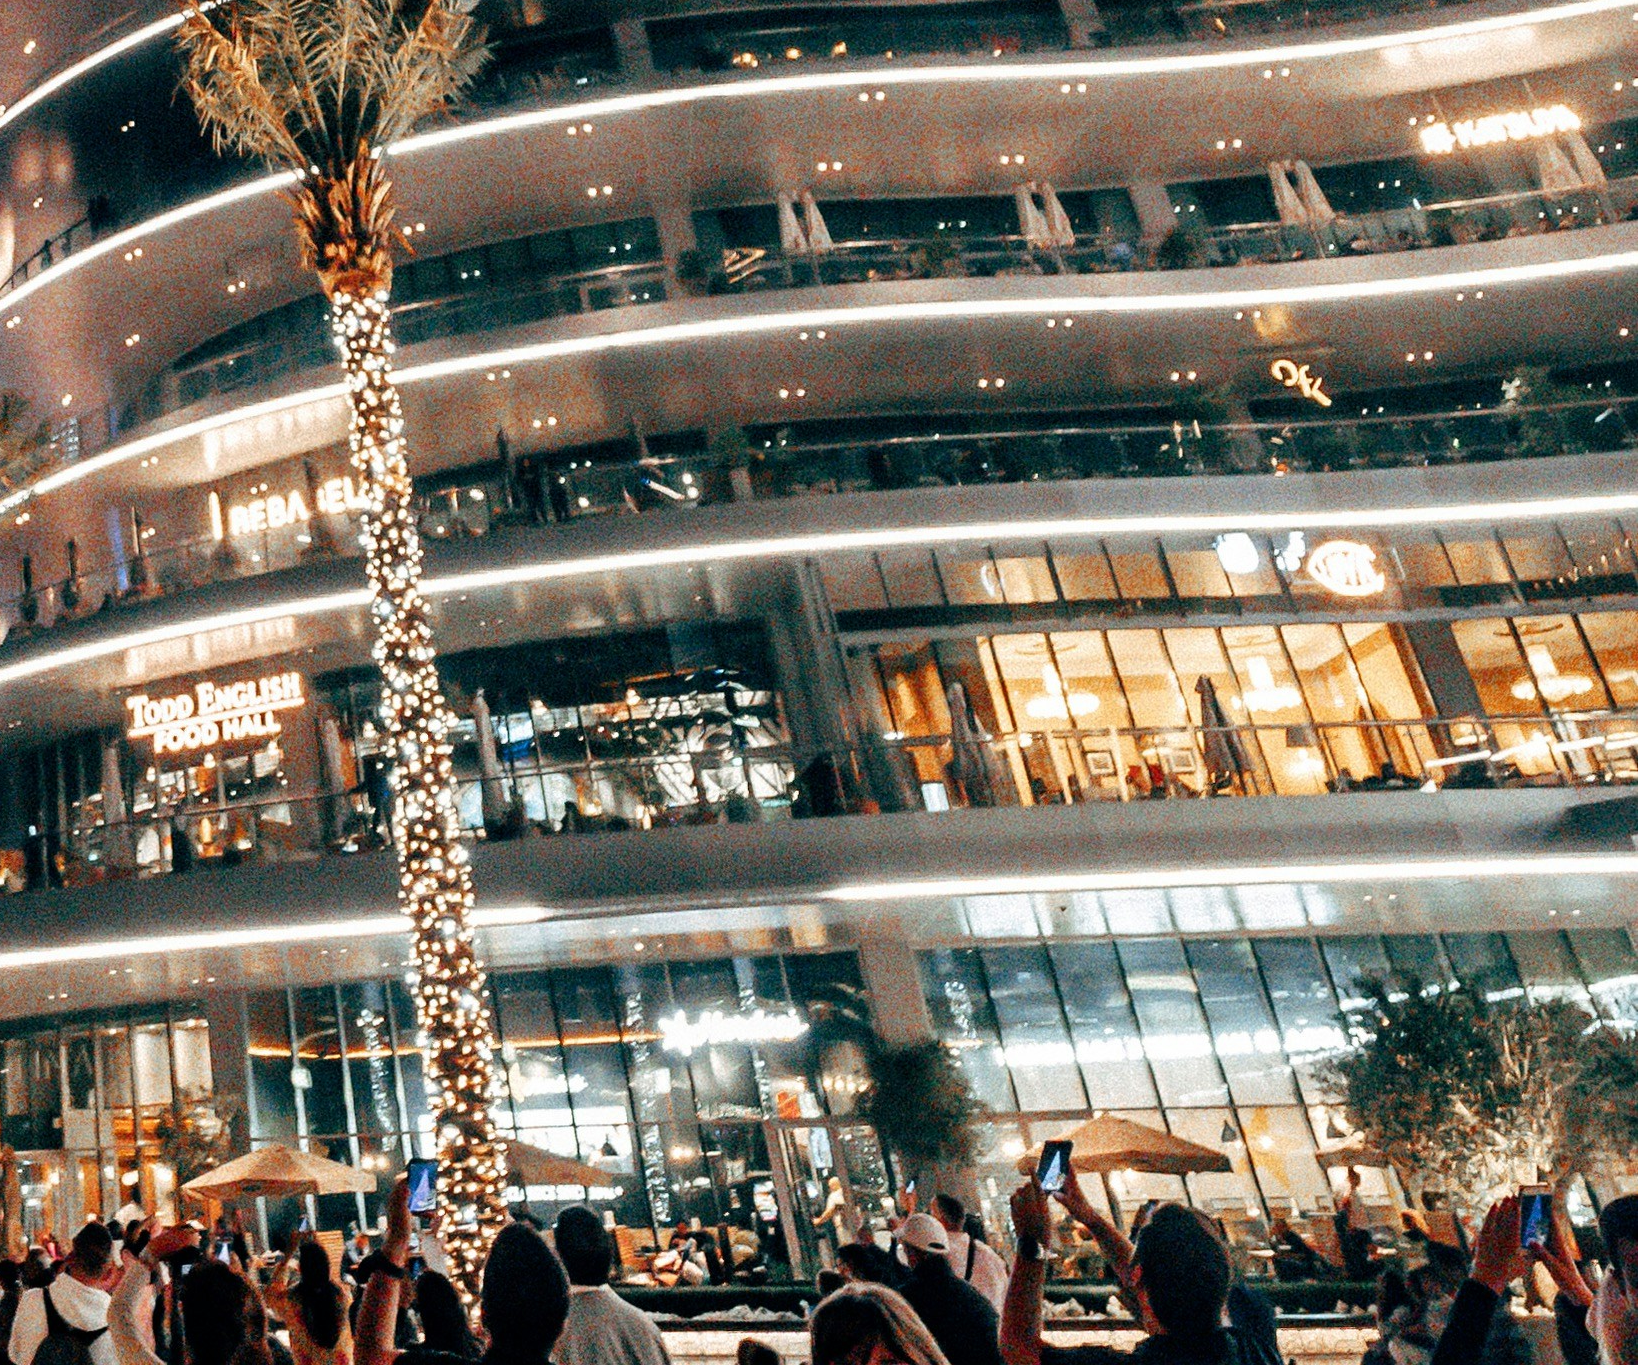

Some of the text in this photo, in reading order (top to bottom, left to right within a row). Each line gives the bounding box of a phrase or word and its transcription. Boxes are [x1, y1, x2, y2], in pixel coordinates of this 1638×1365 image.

[126, 672, 301, 728] TODD ENGLISH
[153, 710, 282, 754] FOOD HALL
